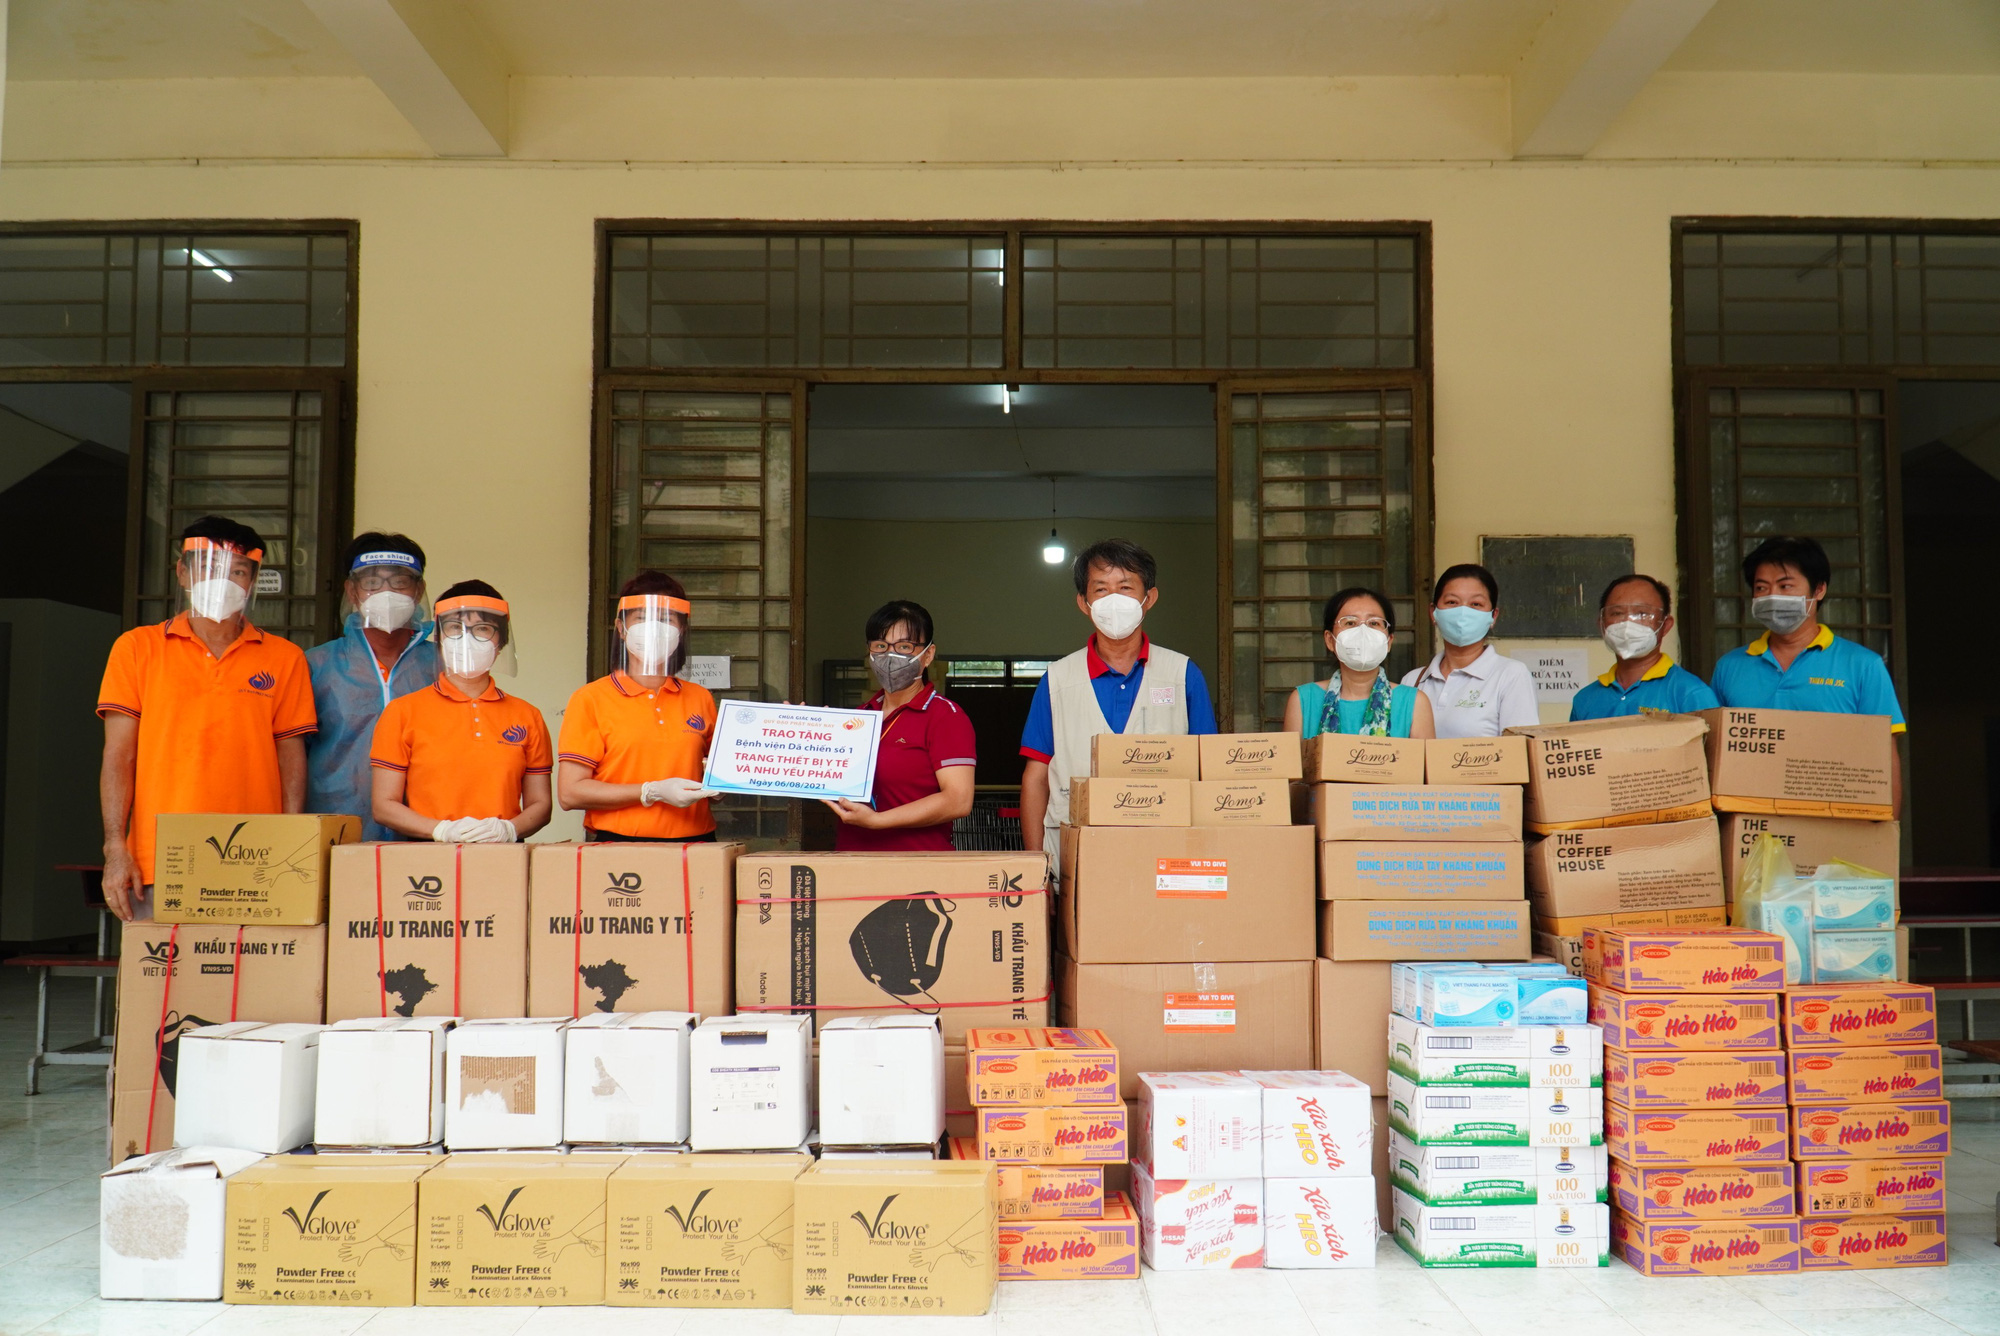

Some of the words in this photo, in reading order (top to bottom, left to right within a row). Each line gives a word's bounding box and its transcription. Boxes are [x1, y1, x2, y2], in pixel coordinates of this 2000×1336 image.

[387, 553, 411, 561] shield
[1730, 712, 1756, 724] THE
[762, 728, 795, 739] TRAO
[799, 729, 832, 742] TẶNG
[1729, 727, 1785, 740] COFFEE
[736, 739, 762, 749] Bệnh
[765, 740, 784, 751] viện
[804, 743, 831, 753] chiến
[834, 745, 846, 754] số
[1543, 739, 1571, 751] THE
[1728, 741, 1776, 754] HOUSE
[734, 752, 774, 763] TRANG
[777, 754, 810, 766] THIẾT
[812, 758, 823, 768] BỊ
[824, 759, 833, 767] Y
[836, 757, 849, 768] TẾ
[1122, 747, 1174, 764] Lomos
[1226, 746, 1277, 764] Lomos
[1347, 749, 1400, 765] Lomos
[1452, 751, 1503, 769] Lomos
[1545, 748, 1602, 765] COFFEE
[736, 764, 751, 773] VÀ
[754, 766, 779, 775] NHU
[783, 766, 805, 777] YẾU
[1547, 764, 1596, 779] HOUSE
[749, 778, 772, 787] Ngày
[775, 780, 826, 789] 06/08/2021
[1114, 791, 1166, 809] Lomos
[1214, 793, 1266, 811] Lomos
[1352, 801, 1377, 811] DUNG
[1379, 801, 1399, 813] DỊCH
[1422, 801, 1436, 811] TAY
[1742, 819, 1768, 831] THE
[205, 821, 269, 861] VGlove
[1557, 834, 1583, 845] THE
[1557, 846, 1612, 858] COFFEE
[1558, 860, 1605, 872] HOUSE
[408, 876, 443, 893] VD
[608, 872, 642, 890] VD
[989, 874, 998, 890] VIET
[201, 888, 235, 896] Powder
[238, 888, 259, 896] Free
[408, 901, 423, 910] VIET
[426, 901, 442, 911] DUC
[608, 898, 623, 907] VIET
[626, 898, 641, 907] DUC
[760, 893, 771, 924] FDA
[399, 920, 454, 938] TRANG
[459, 920, 470, 937] Y
[475, 914, 495, 937] TẾ
[600, 917, 653, 934] TRANG
[659, 917, 669, 934] Y
[194, 937, 226, 954] KHẨU
[272, 943, 278, 954] Y
[282, 939, 296, 955] TẾ
[1012, 923, 1028, 953] KHẨU
[143, 967, 159, 976] VIET
[1013, 957, 1024, 993] TRANG
[1703, 968, 1729, 984] Hảo
[1731, 964, 1758, 980] Hảo
[1013, 1007, 1028, 1020] TẾ
[1830, 1009, 1862, 1033] Hảo
[1865, 1004, 1898, 1027] Hảo
[1665, 1015, 1700, 1038] Hảo
[1703, 1010, 1737, 1033] Hảo
[1046, 1068, 1076, 1088] Hảo
[1077, 1064, 1108, 1084] Hảo
[1549, 1064, 1572, 1076] 100
[1297, 1096, 1327, 1131] Xúc
[1318, 1131, 1345, 1171] xích
[1292, 1123, 1318, 1165] HEO
[282, 1188, 357, 1234] VGlove
[476, 1185, 551, 1231] VGlove
[664, 1188, 739, 1233] VGlove
[850, 1193, 926, 1239] VGlove
[1299, 1186, 1331, 1221] Xúc
[1321, 1221, 1348, 1261] xích
[1295, 1213, 1322, 1256] HEO
[1022, 1242, 1058, 1265] Hảo
[1060, 1237, 1096, 1259] Hảo
[276, 1267, 317, 1277] Powder
[320, 1267, 344, 1277] Free
[471, 1265, 512, 1274] Powder
[516, 1265, 540, 1274] Free
[661, 1266, 701, 1276] Powder
[705, 1267, 728, 1276] Free
[848, 1273, 889, 1283] Powder
[892, 1274, 916, 1283] Free
